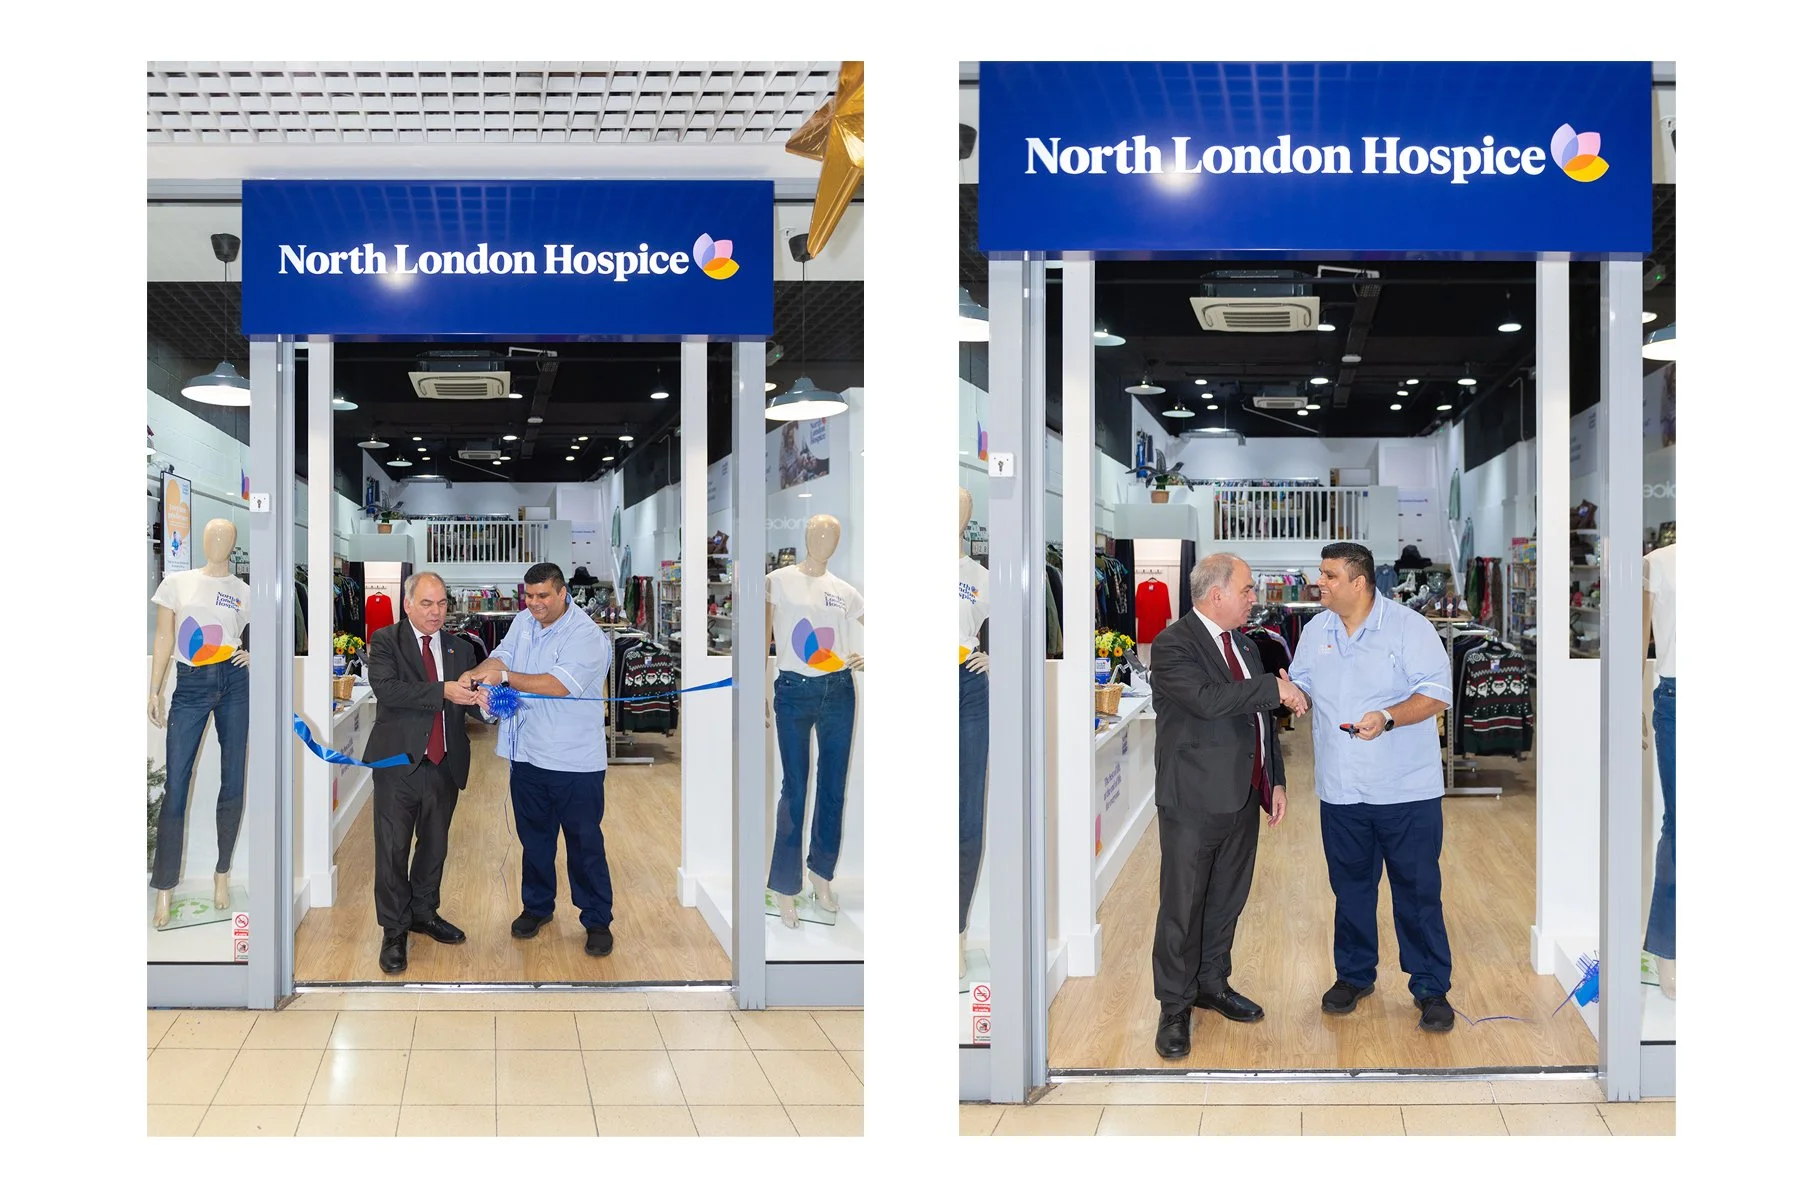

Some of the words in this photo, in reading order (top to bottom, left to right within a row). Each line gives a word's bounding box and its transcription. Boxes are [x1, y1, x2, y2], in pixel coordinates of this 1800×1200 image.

[1025, 135, 1163, 175] North
[1170, 135, 1354, 175] London
[1361, 135, 1546, 184] Hospice
[278, 243, 387, 275] North
[394, 243, 538, 275] London
[543, 243, 690, 282] Hospice
